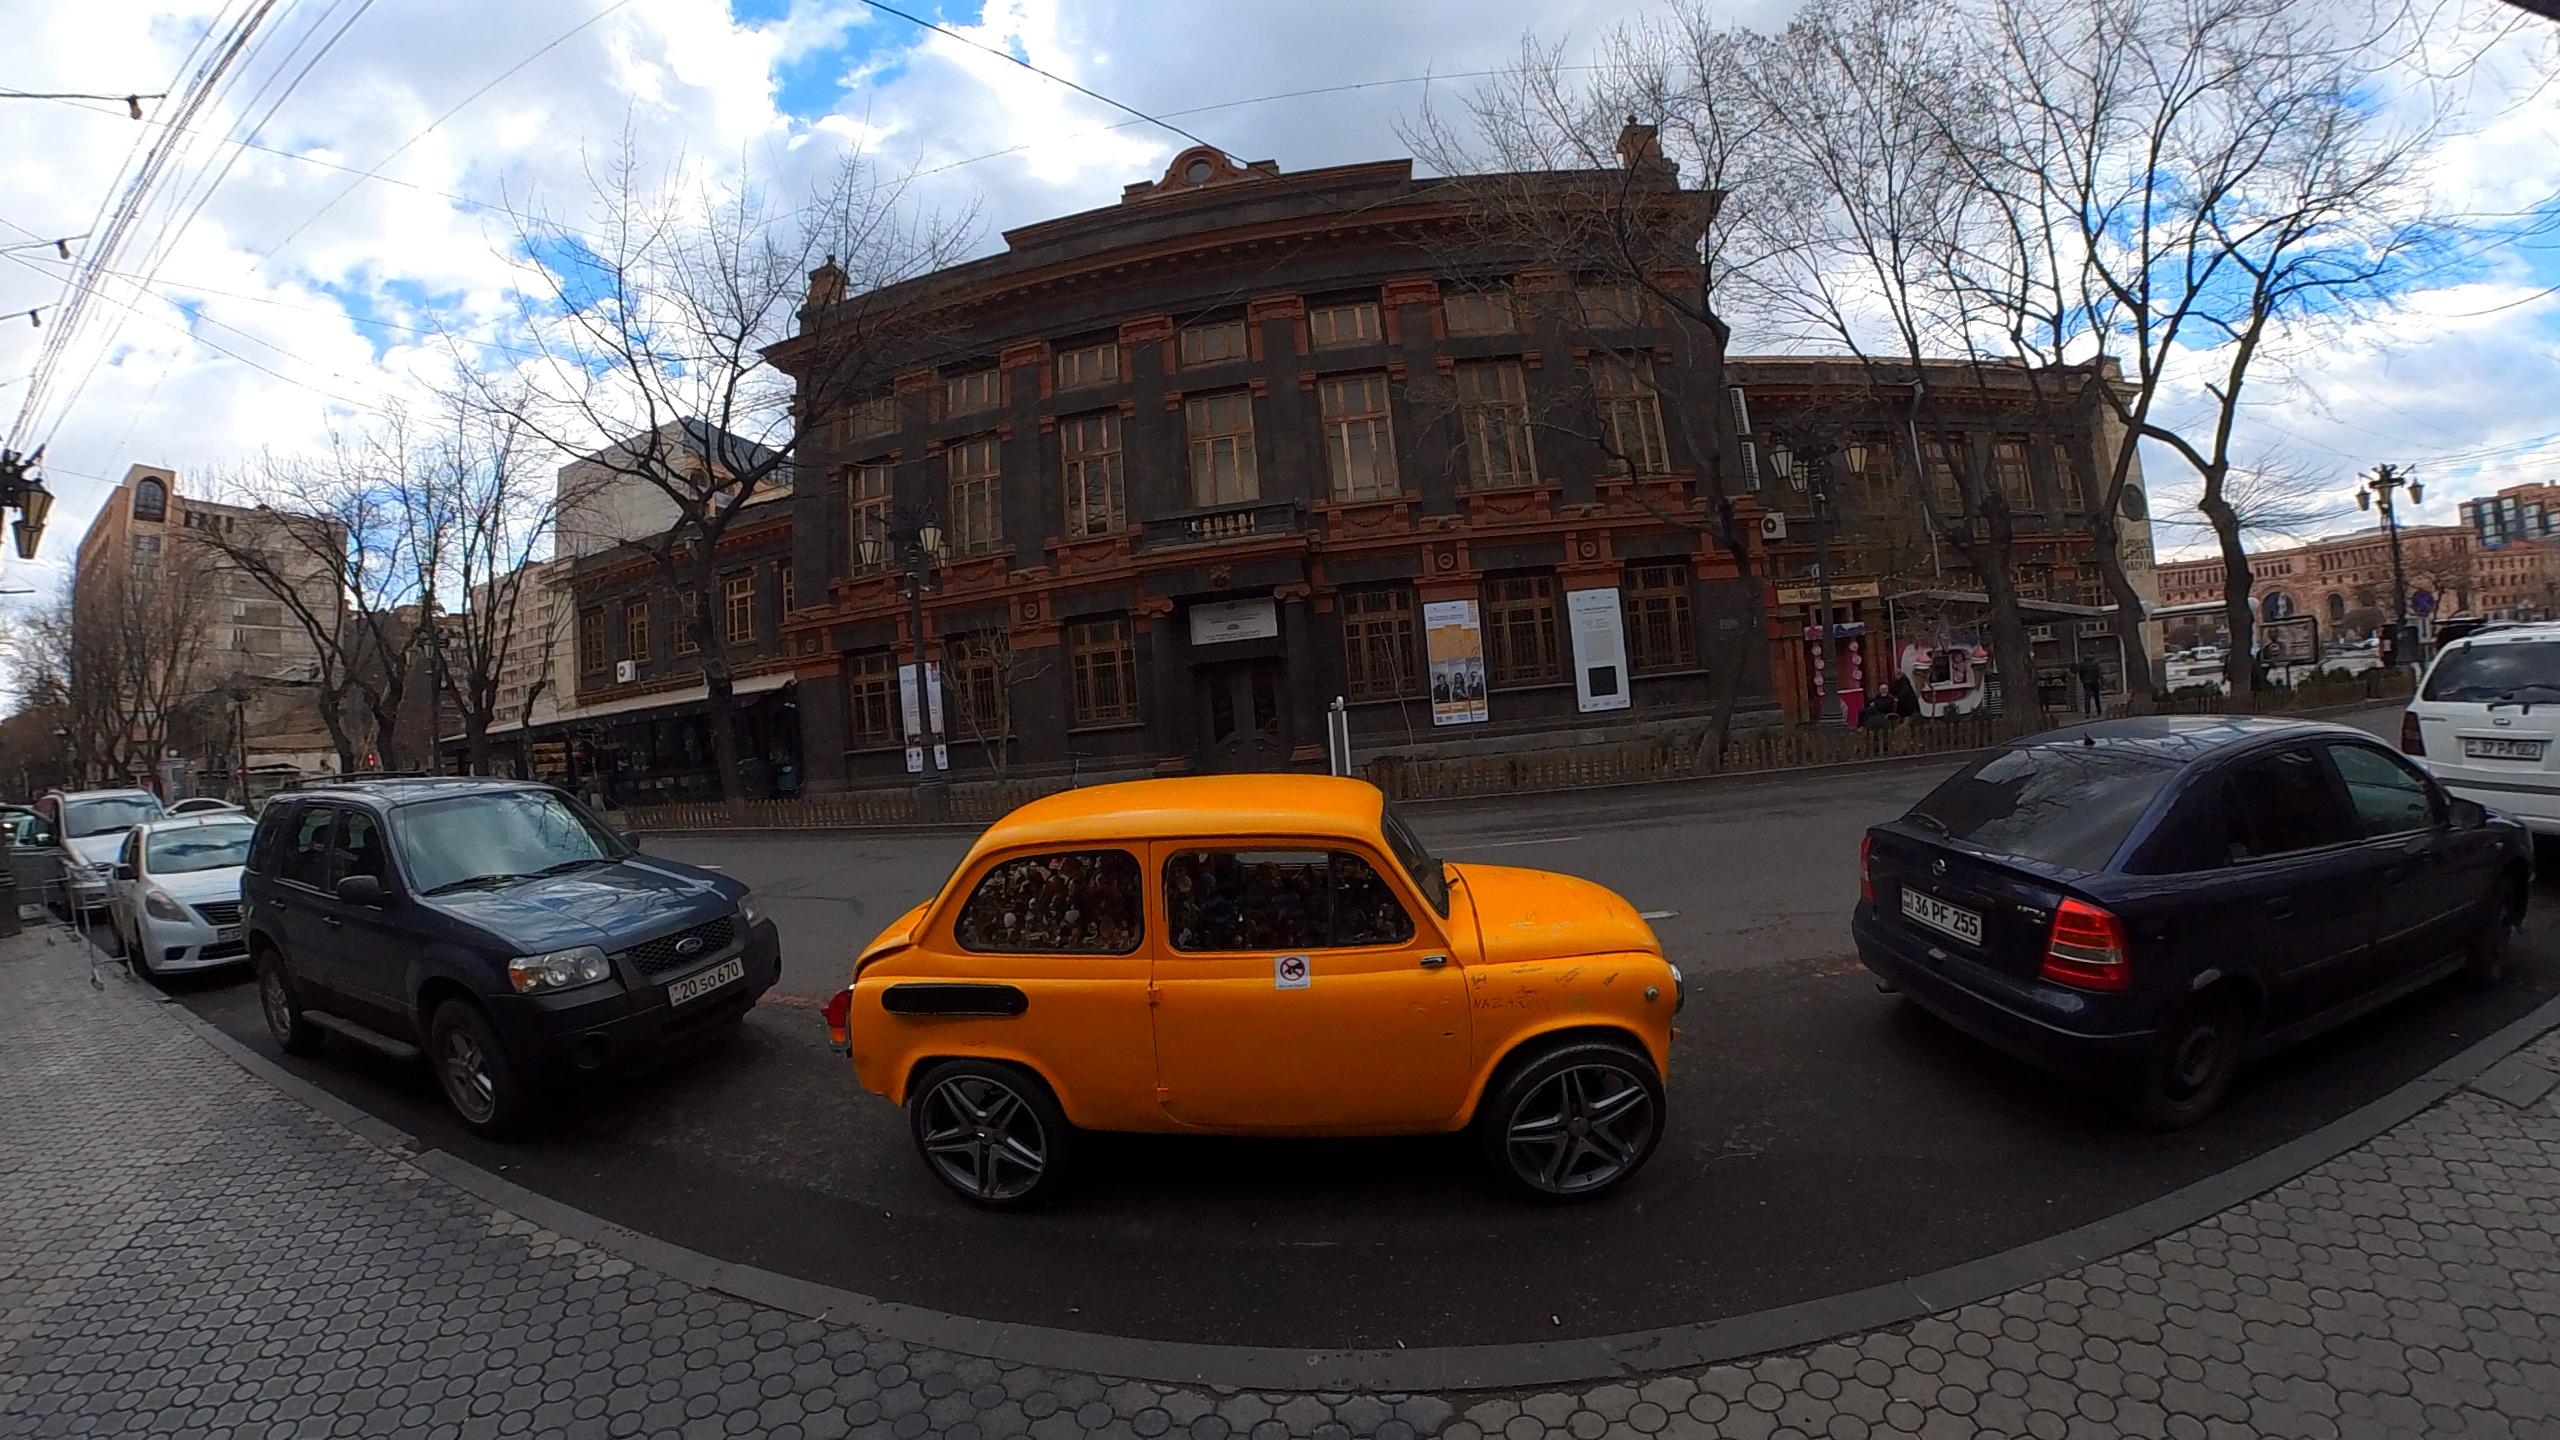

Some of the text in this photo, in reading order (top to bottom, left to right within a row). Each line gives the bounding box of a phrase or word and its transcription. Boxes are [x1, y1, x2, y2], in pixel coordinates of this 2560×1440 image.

[2480, 741, 2494, 754] 37
[1914, 894, 1929, 917] 36
[1931, 901, 1949, 924] PF
[1952, 910, 1978, 937] 255
[680, 980, 697, 999] 20
[718, 962, 739, 983] 670
